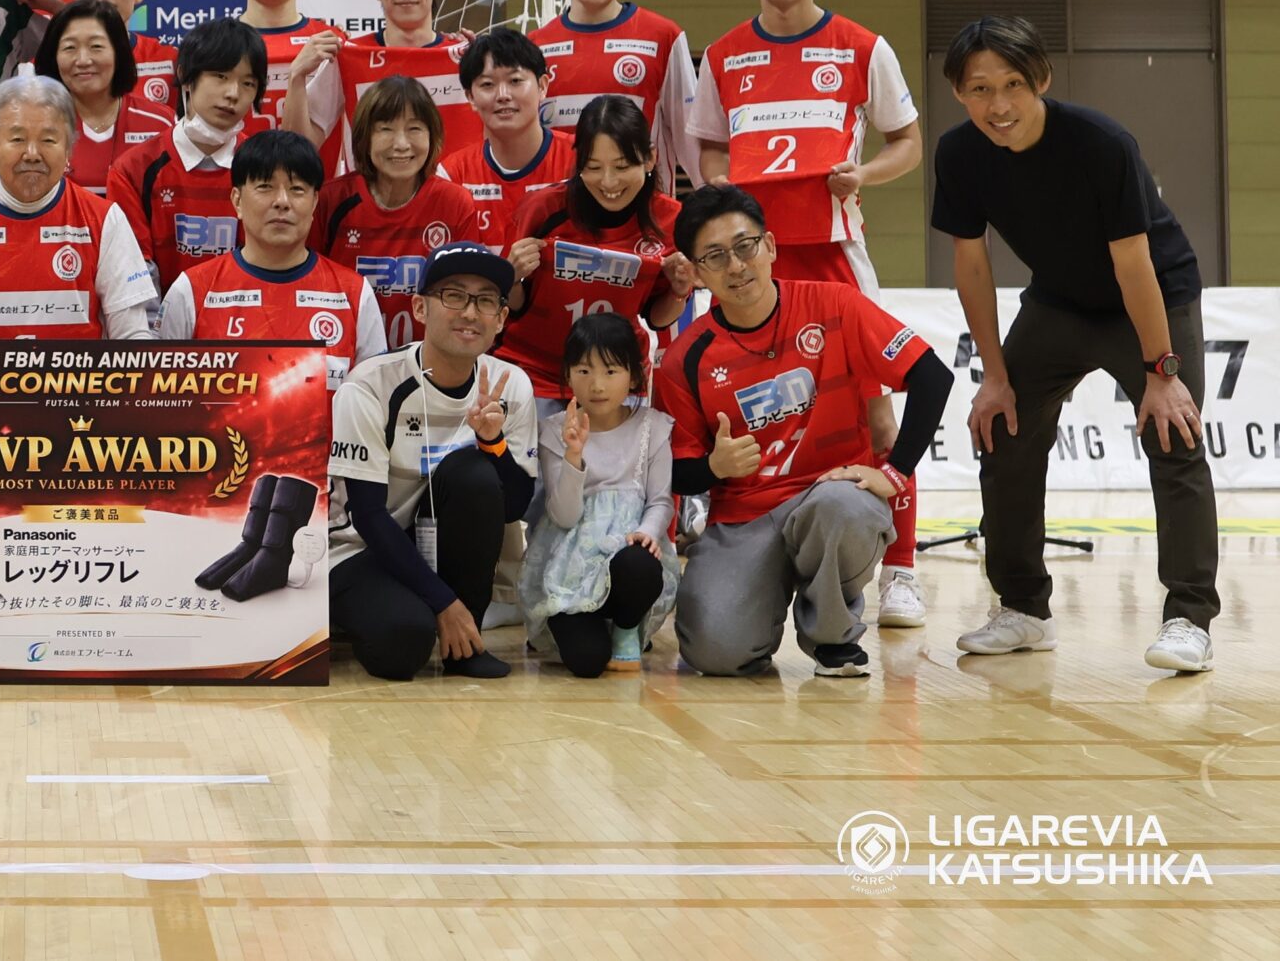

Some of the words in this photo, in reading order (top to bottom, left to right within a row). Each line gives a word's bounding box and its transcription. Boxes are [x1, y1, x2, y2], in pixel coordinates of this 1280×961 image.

[762, 135, 797, 174] 2
[555, 269, 632, 287] エフ・ビー・エム
[3, 351, 46, 369] FBM
[51, 350, 93, 369] 50th
[97, 351, 238, 370] ANNIVERSARY
[0, 373, 141, 395] CONNECT
[149, 373, 258, 395] MATCH
[45, 399, 80, 407] FUTSAL
[95, 399, 120, 407] TEAM
[135, 399, 193, 407] COMMUNITY
[62, 435, 218, 473] AWARD
[331, 441, 368, 461] OKYO
[39, 479, 113, 491] VALUABLE
[120, 479, 176, 491] PLAYER
[52, 509, 119, 521] ご褒美賞品
[4, 529, 77, 541] Panasonic
[4, 545, 145, 557] 家庭用エアーマッサージャー
[5, 559, 140, 583] レッグリフレ
